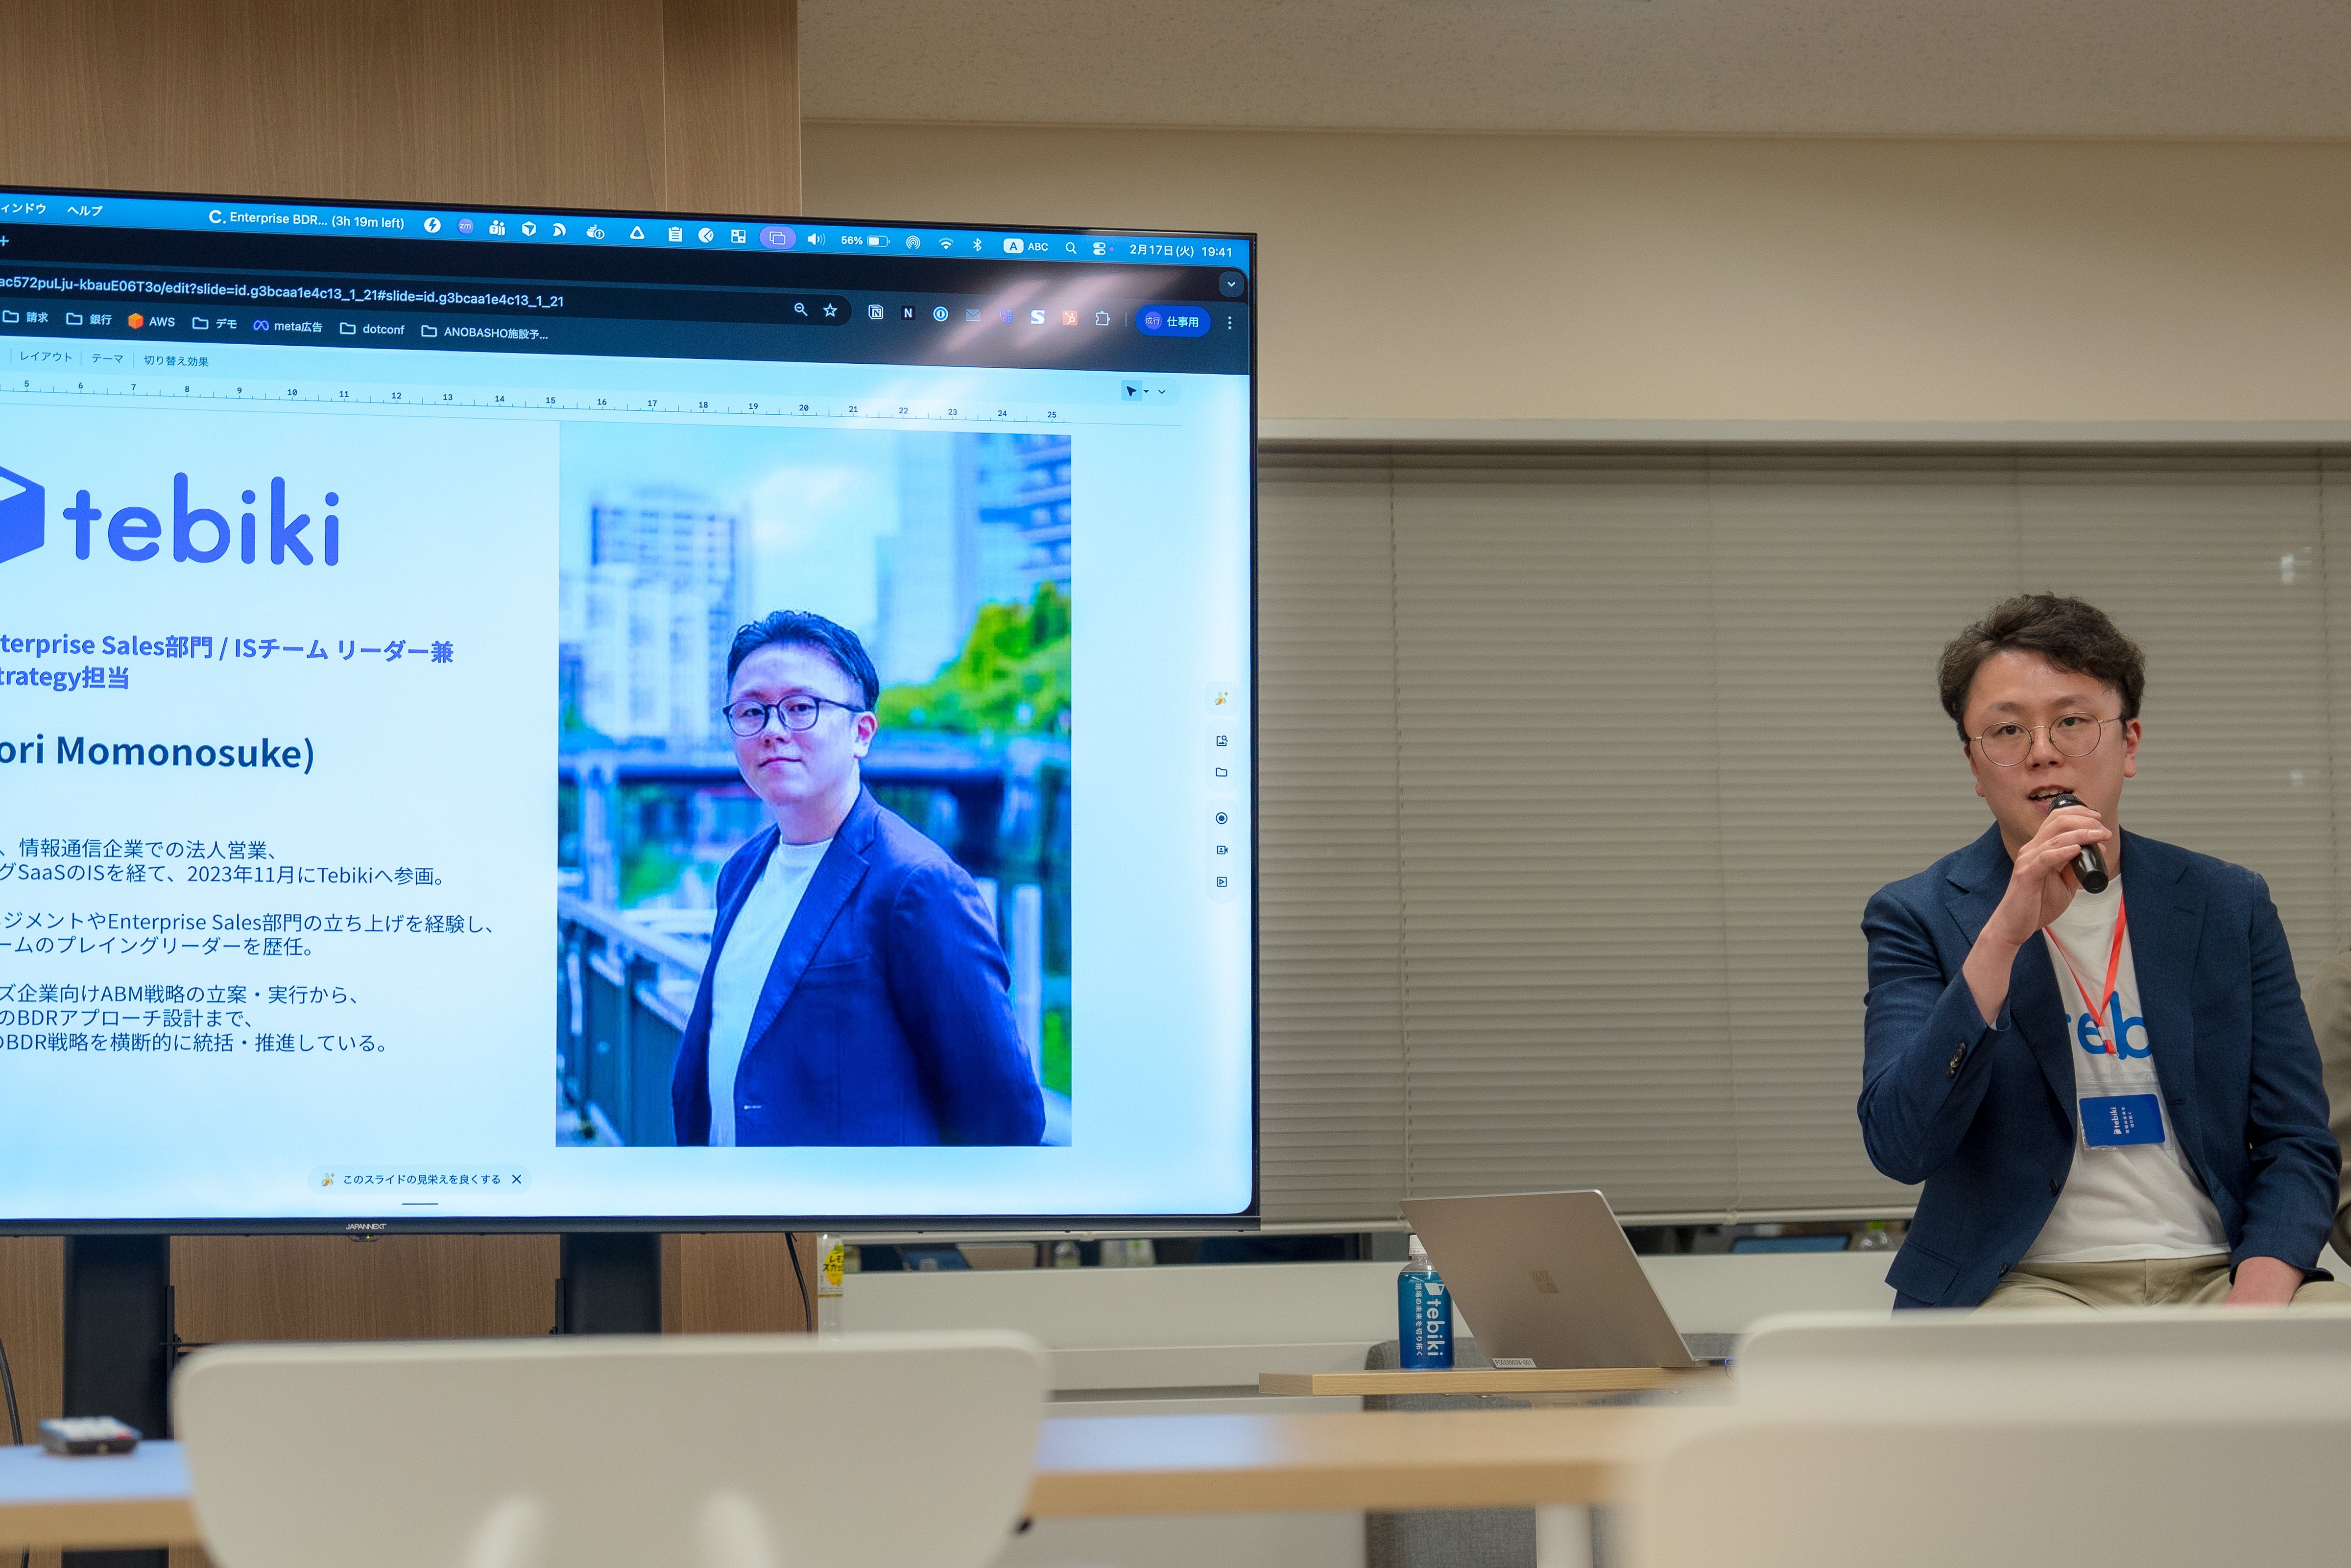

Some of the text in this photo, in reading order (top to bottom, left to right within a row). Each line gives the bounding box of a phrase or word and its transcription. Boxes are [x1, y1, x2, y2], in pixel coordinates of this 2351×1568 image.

[68, 206, 103, 216] ヘルプ
[231, 212, 289, 224] Enterprise
[332, 215, 350, 227] (3h
[354, 217, 378, 227] 19m
[382, 217, 404, 230] left)
[841, 236, 863, 244] 56%
[1130, 244, 1231, 258] 2月17日(火) 19:41
[27, 312, 48, 322] 請求
[90, 314, 112, 325] 銀行
[149, 317, 175, 327] AWS
[1145, 316, 1161, 325] 成行
[1167, 316, 1198, 327] 仕事用
[216, 318, 237, 329] デモ
[275, 322, 322, 332] meta広告
[363, 324, 405, 334] dotconf
[21, 352, 72, 362] レイアウト
[92, 354, 123, 363] テーマ
[144, 356, 208, 366] 切り替え効果
[63, 473, 338, 566] tebiki
[0, 634, 454, 663] terprise Sales部門 / ISチーム リーダー兼
[0, 734, 313, 774] ori Momonosuke)
[0, 912, 206, 934] ジメントやEnterprise
[0, 936, 311, 955] ームのプレイングリーダーを歴任。
[0, 984, 356, 1004] ズ企業向けABM戦略の立案・実行から、
[0, 1009, 250, 1027] のBDRアプローチ設計まで、
[2066, 990, 2152, 1060] eb
[0, 1033, 384, 1052] BDR戦略を横断的に統括・推進している。
[2110, 1107, 2120, 1128] tebiki
[344, 1174, 500, 1185] このスライドの見栄えを良くする
[1427, 1299, 1445, 1355] tebiki
